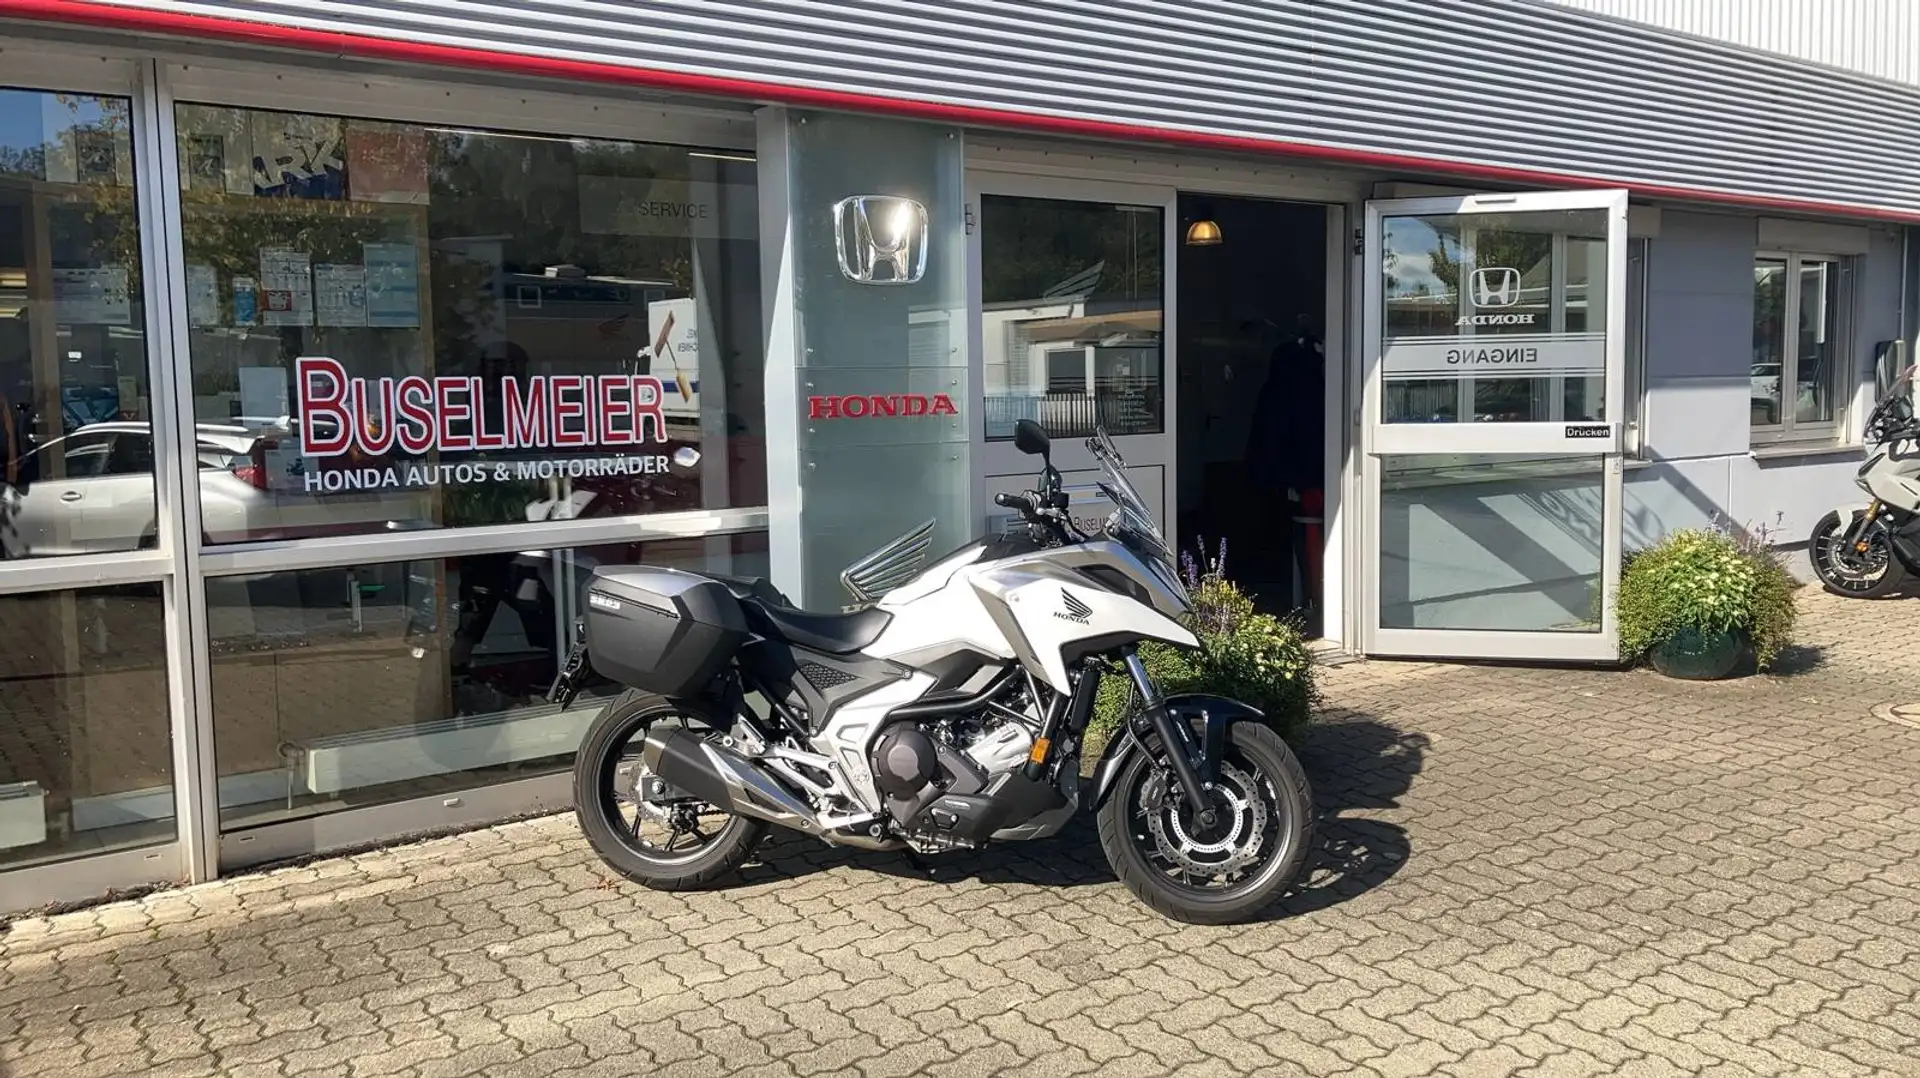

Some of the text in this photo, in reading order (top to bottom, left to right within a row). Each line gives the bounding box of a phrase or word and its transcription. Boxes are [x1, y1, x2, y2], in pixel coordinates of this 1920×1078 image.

[639, 201, 709, 219] SERVICE
[295, 356, 668, 457] BUSELMEIER
[808, 393, 958, 420] HONDA
[304, 453, 670, 492] HONDA AUTOS & MOTORRÄDER
[1053, 612, 1090, 625] HONDA
